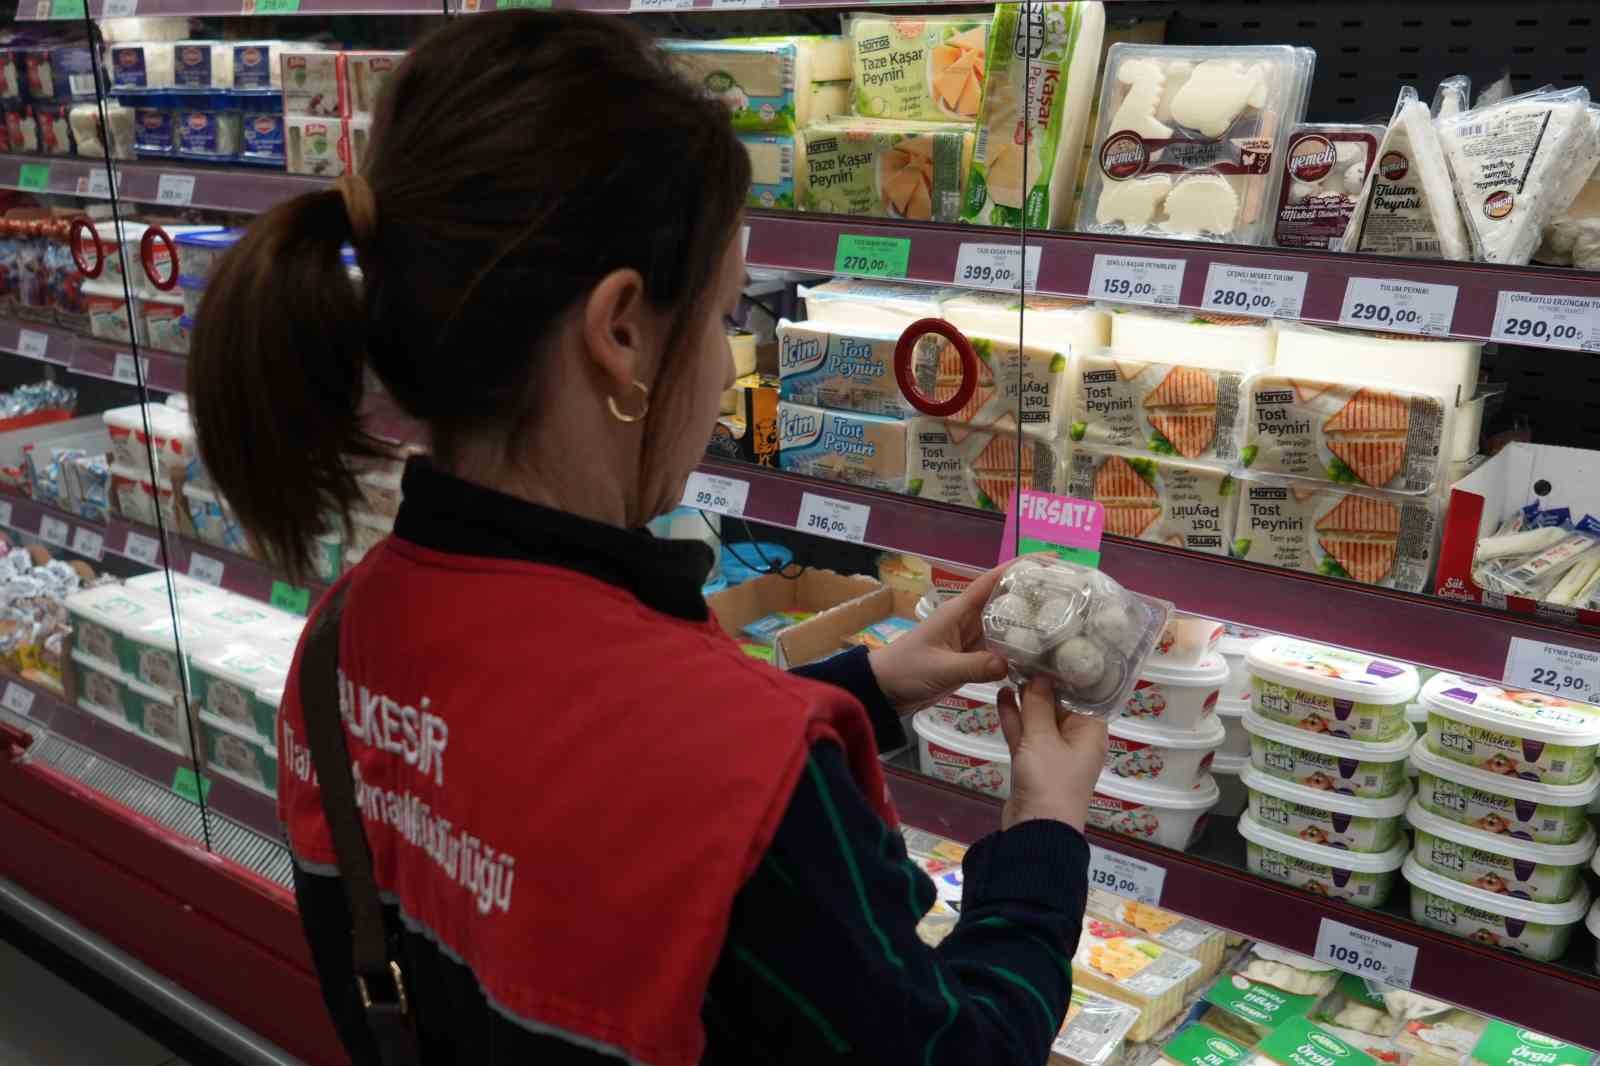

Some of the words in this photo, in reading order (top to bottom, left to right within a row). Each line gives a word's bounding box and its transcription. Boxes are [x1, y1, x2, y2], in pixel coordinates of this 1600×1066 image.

[861, 57, 887, 71] Taze
[889, 49, 924, 66] Kaşar
[863, 66, 904, 87] Peyniri
[1038, 68, 1061, 130] Kaşar
[808, 160, 835, 173] Taze
[838, 152, 873, 168] Kaşar
[809, 168, 853, 188] Peyniri
[1376, 184, 1417, 196] Tulum
[1375, 197, 1424, 213] Peyniri
[840, 338, 873, 359] Tost
[830, 353, 885, 378] Peyniri
[1084, 386, 1113, 399] Tost
[1024, 396, 1051, 408] Tost
[1086, 397, 1134, 414] Peyniri
[1256, 408, 1288, 421] Tost
[832, 416, 865, 438] Tost
[1257, 420, 1311, 437] Peyniri
[825, 431, 876, 458] Peyniri
[920, 447, 945, 458] Tost
[922, 458, 961, 473] Peyniri
[1019, 493, 1097, 532] FIRSAT!
[1171, 503, 1220, 520] Peyniri
[1250, 503, 1280, 516] Tost
[1192, 519, 1222, 532] Tost
[1251, 516, 1304, 533] Peyniri
[337, 668, 449, 786] LIKESİR
